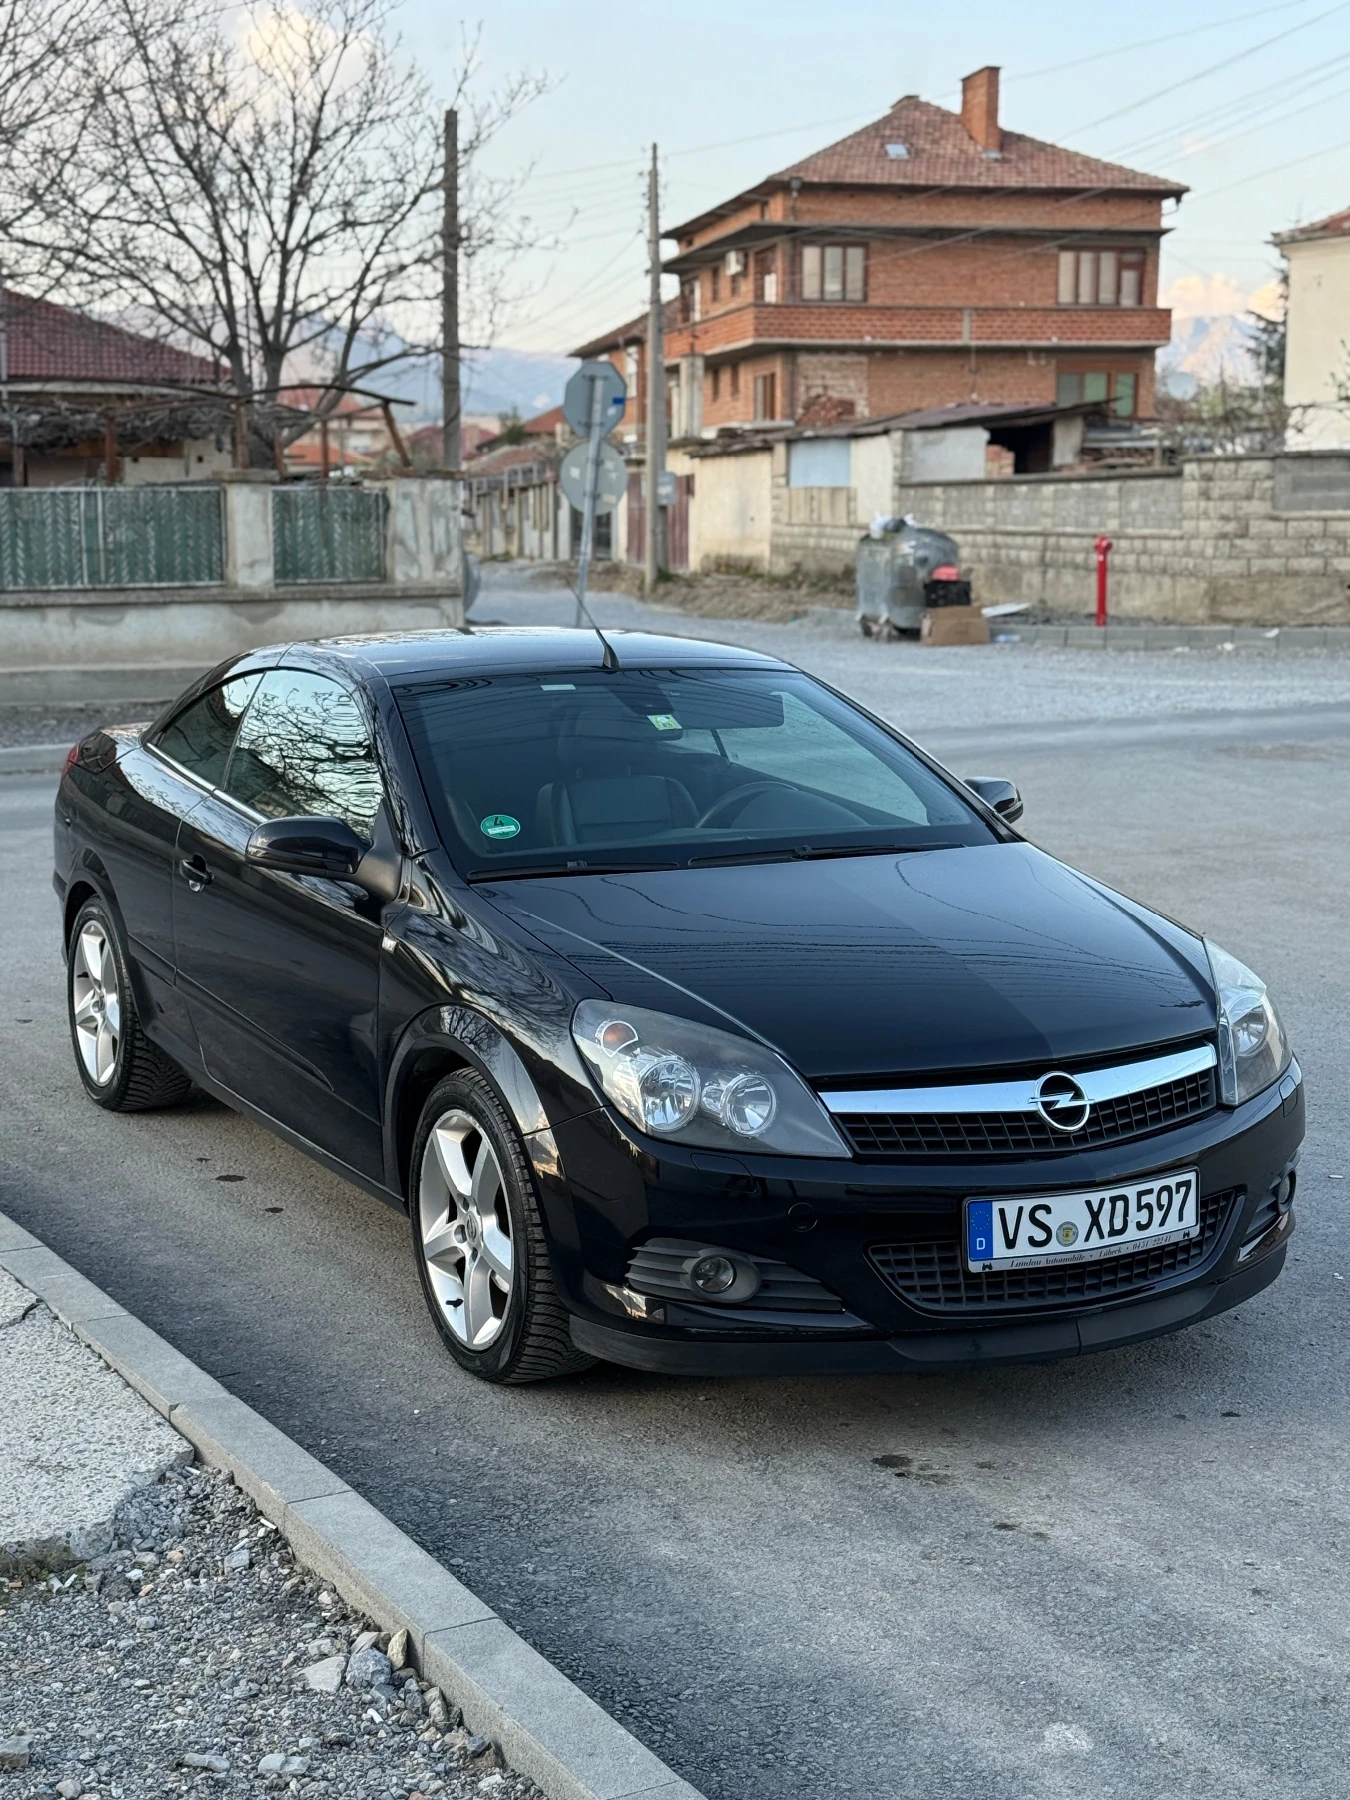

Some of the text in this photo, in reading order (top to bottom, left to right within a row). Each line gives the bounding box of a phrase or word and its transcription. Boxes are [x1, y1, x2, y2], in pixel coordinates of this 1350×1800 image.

[494, 816, 504, 826] 4
[998, 1203, 1053, 1250] VS
[976, 1238, 986, 1250] D
